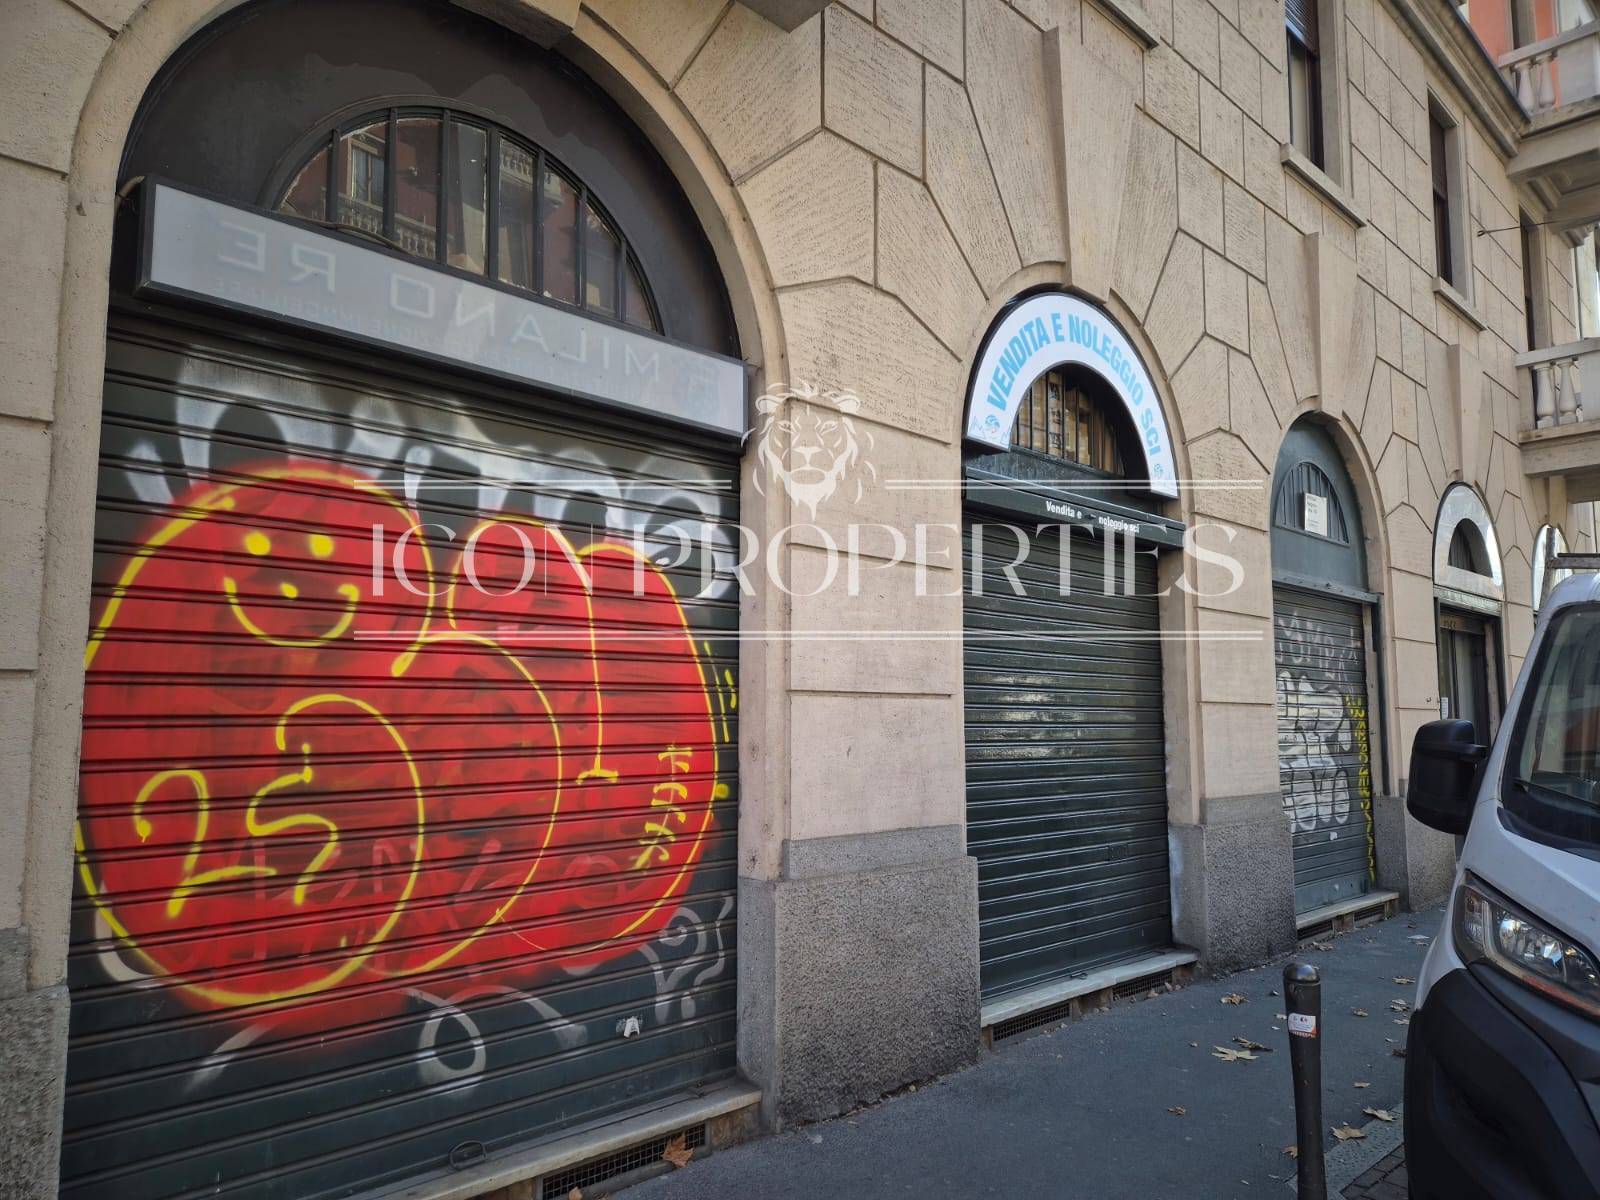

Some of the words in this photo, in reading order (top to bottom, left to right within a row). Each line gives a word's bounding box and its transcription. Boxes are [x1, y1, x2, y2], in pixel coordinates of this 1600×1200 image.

[986, 316, 1050, 411] VENDITA
[1051, 313, 1064, 342] E
[1068, 314, 1144, 406] NOLEGGIO
[1140, 408, 1161, 456] SCI
[1046, 501, 1075, 518] Vendita
[1076, 510, 1082, 519] e
[1098, 516, 1128, 532] noleggio
[1129, 523, 1140, 533] sci
